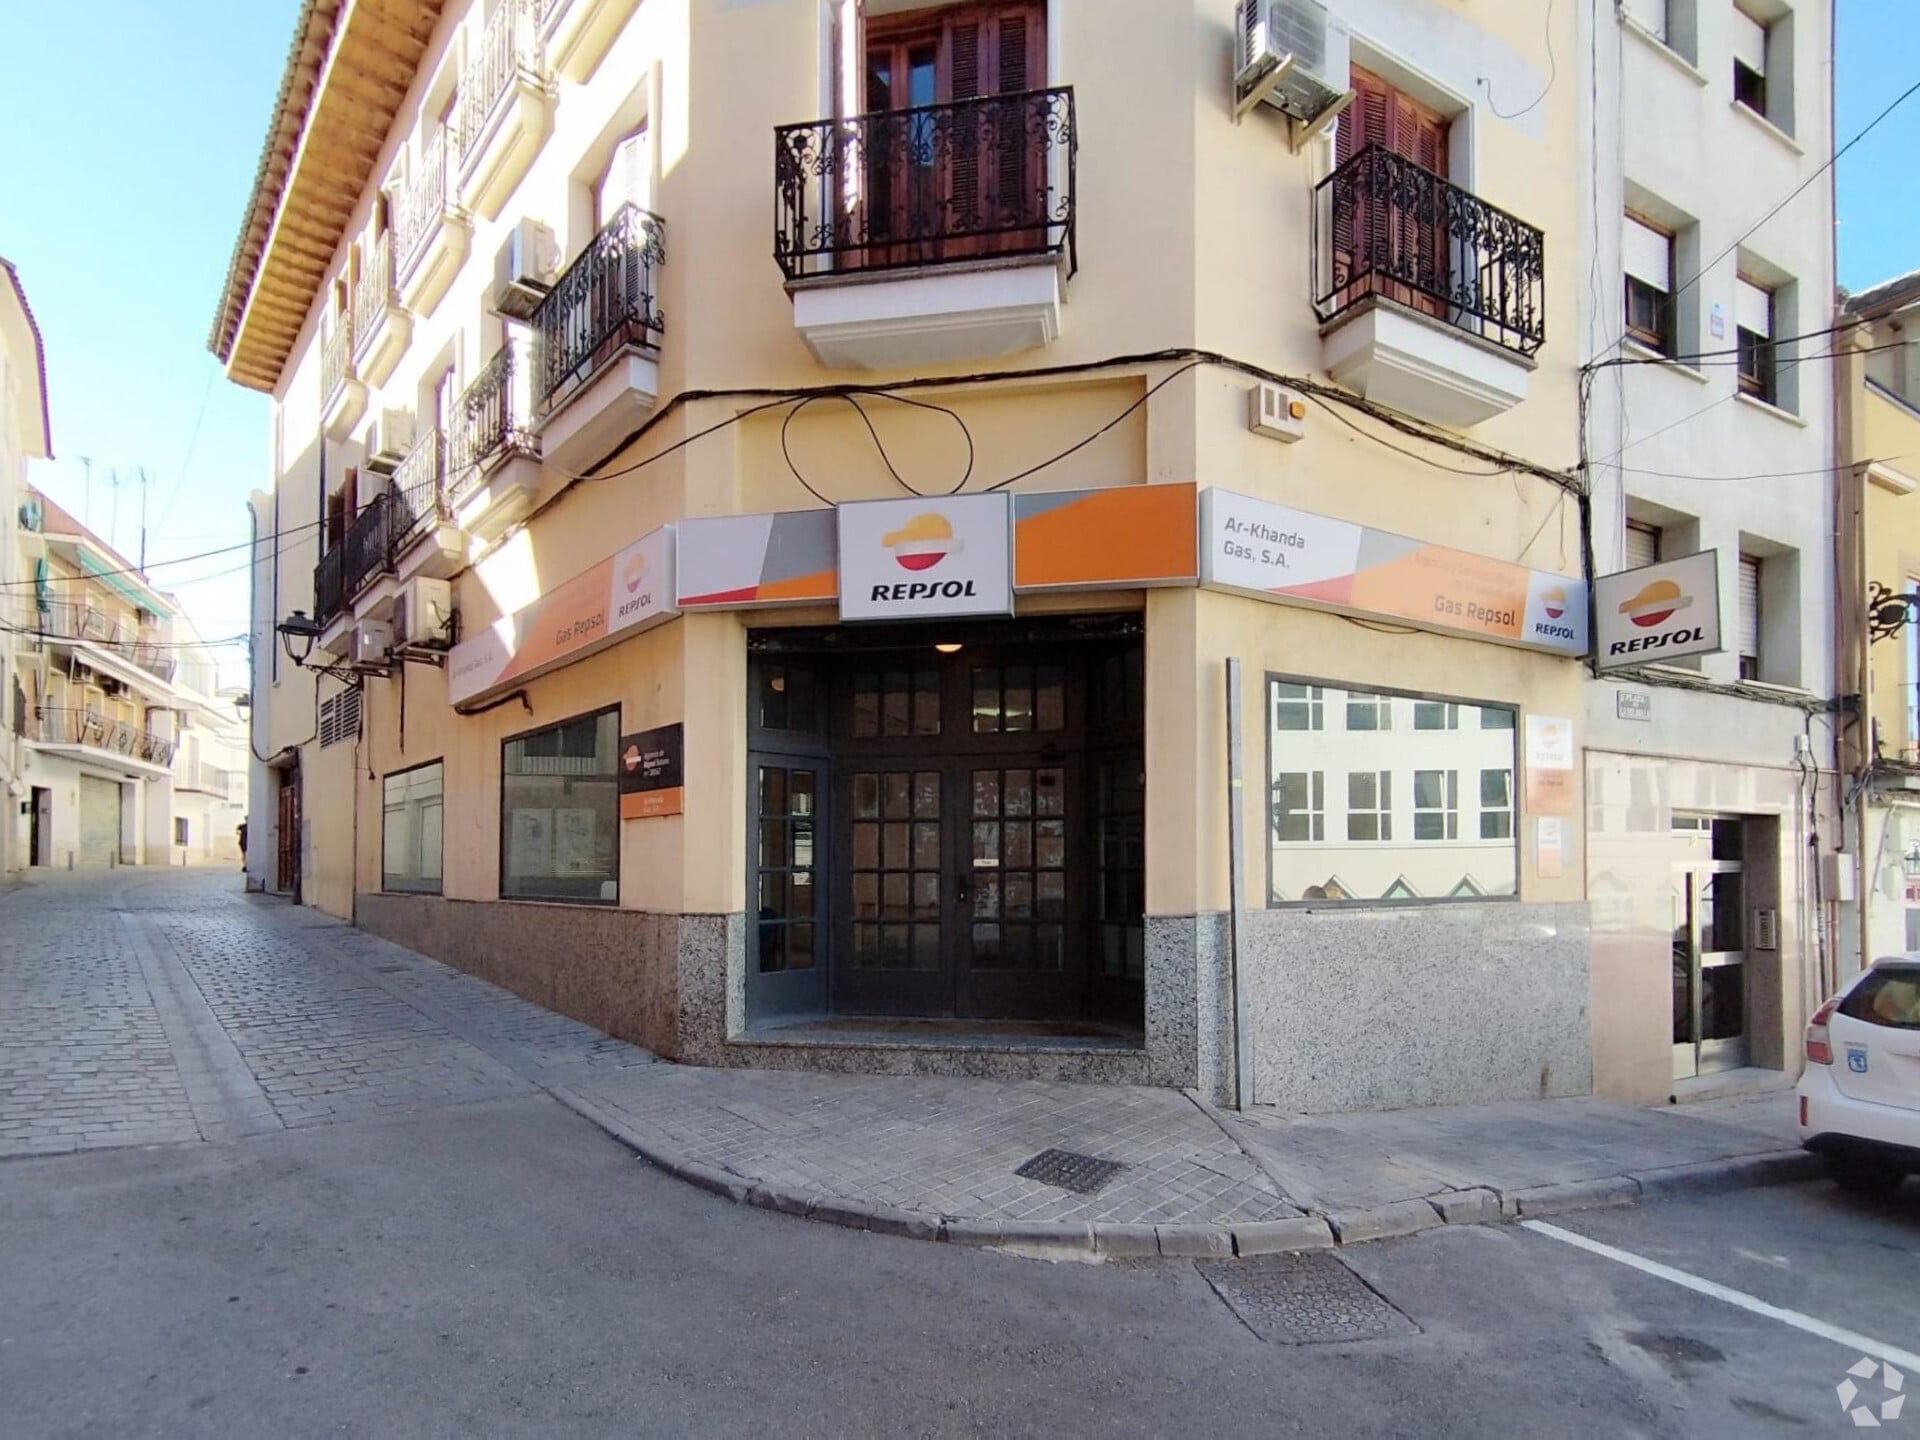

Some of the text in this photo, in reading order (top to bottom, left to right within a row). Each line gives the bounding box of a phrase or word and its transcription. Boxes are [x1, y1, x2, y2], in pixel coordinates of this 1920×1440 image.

[1224, 517, 1306, 549] Ar-Khanda
[1223, 540, 1290, 569] Gas, S.A.
[618, 592, 652, 618] REPSOL
[870, 579, 977, 602] REPSOL
[573, 607, 605, 638] Repsol
[1434, 595, 1516, 626] Gas Repsol
[1535, 622, 1576, 640] REPSOL
[1609, 626, 1705, 656] REPSOL
